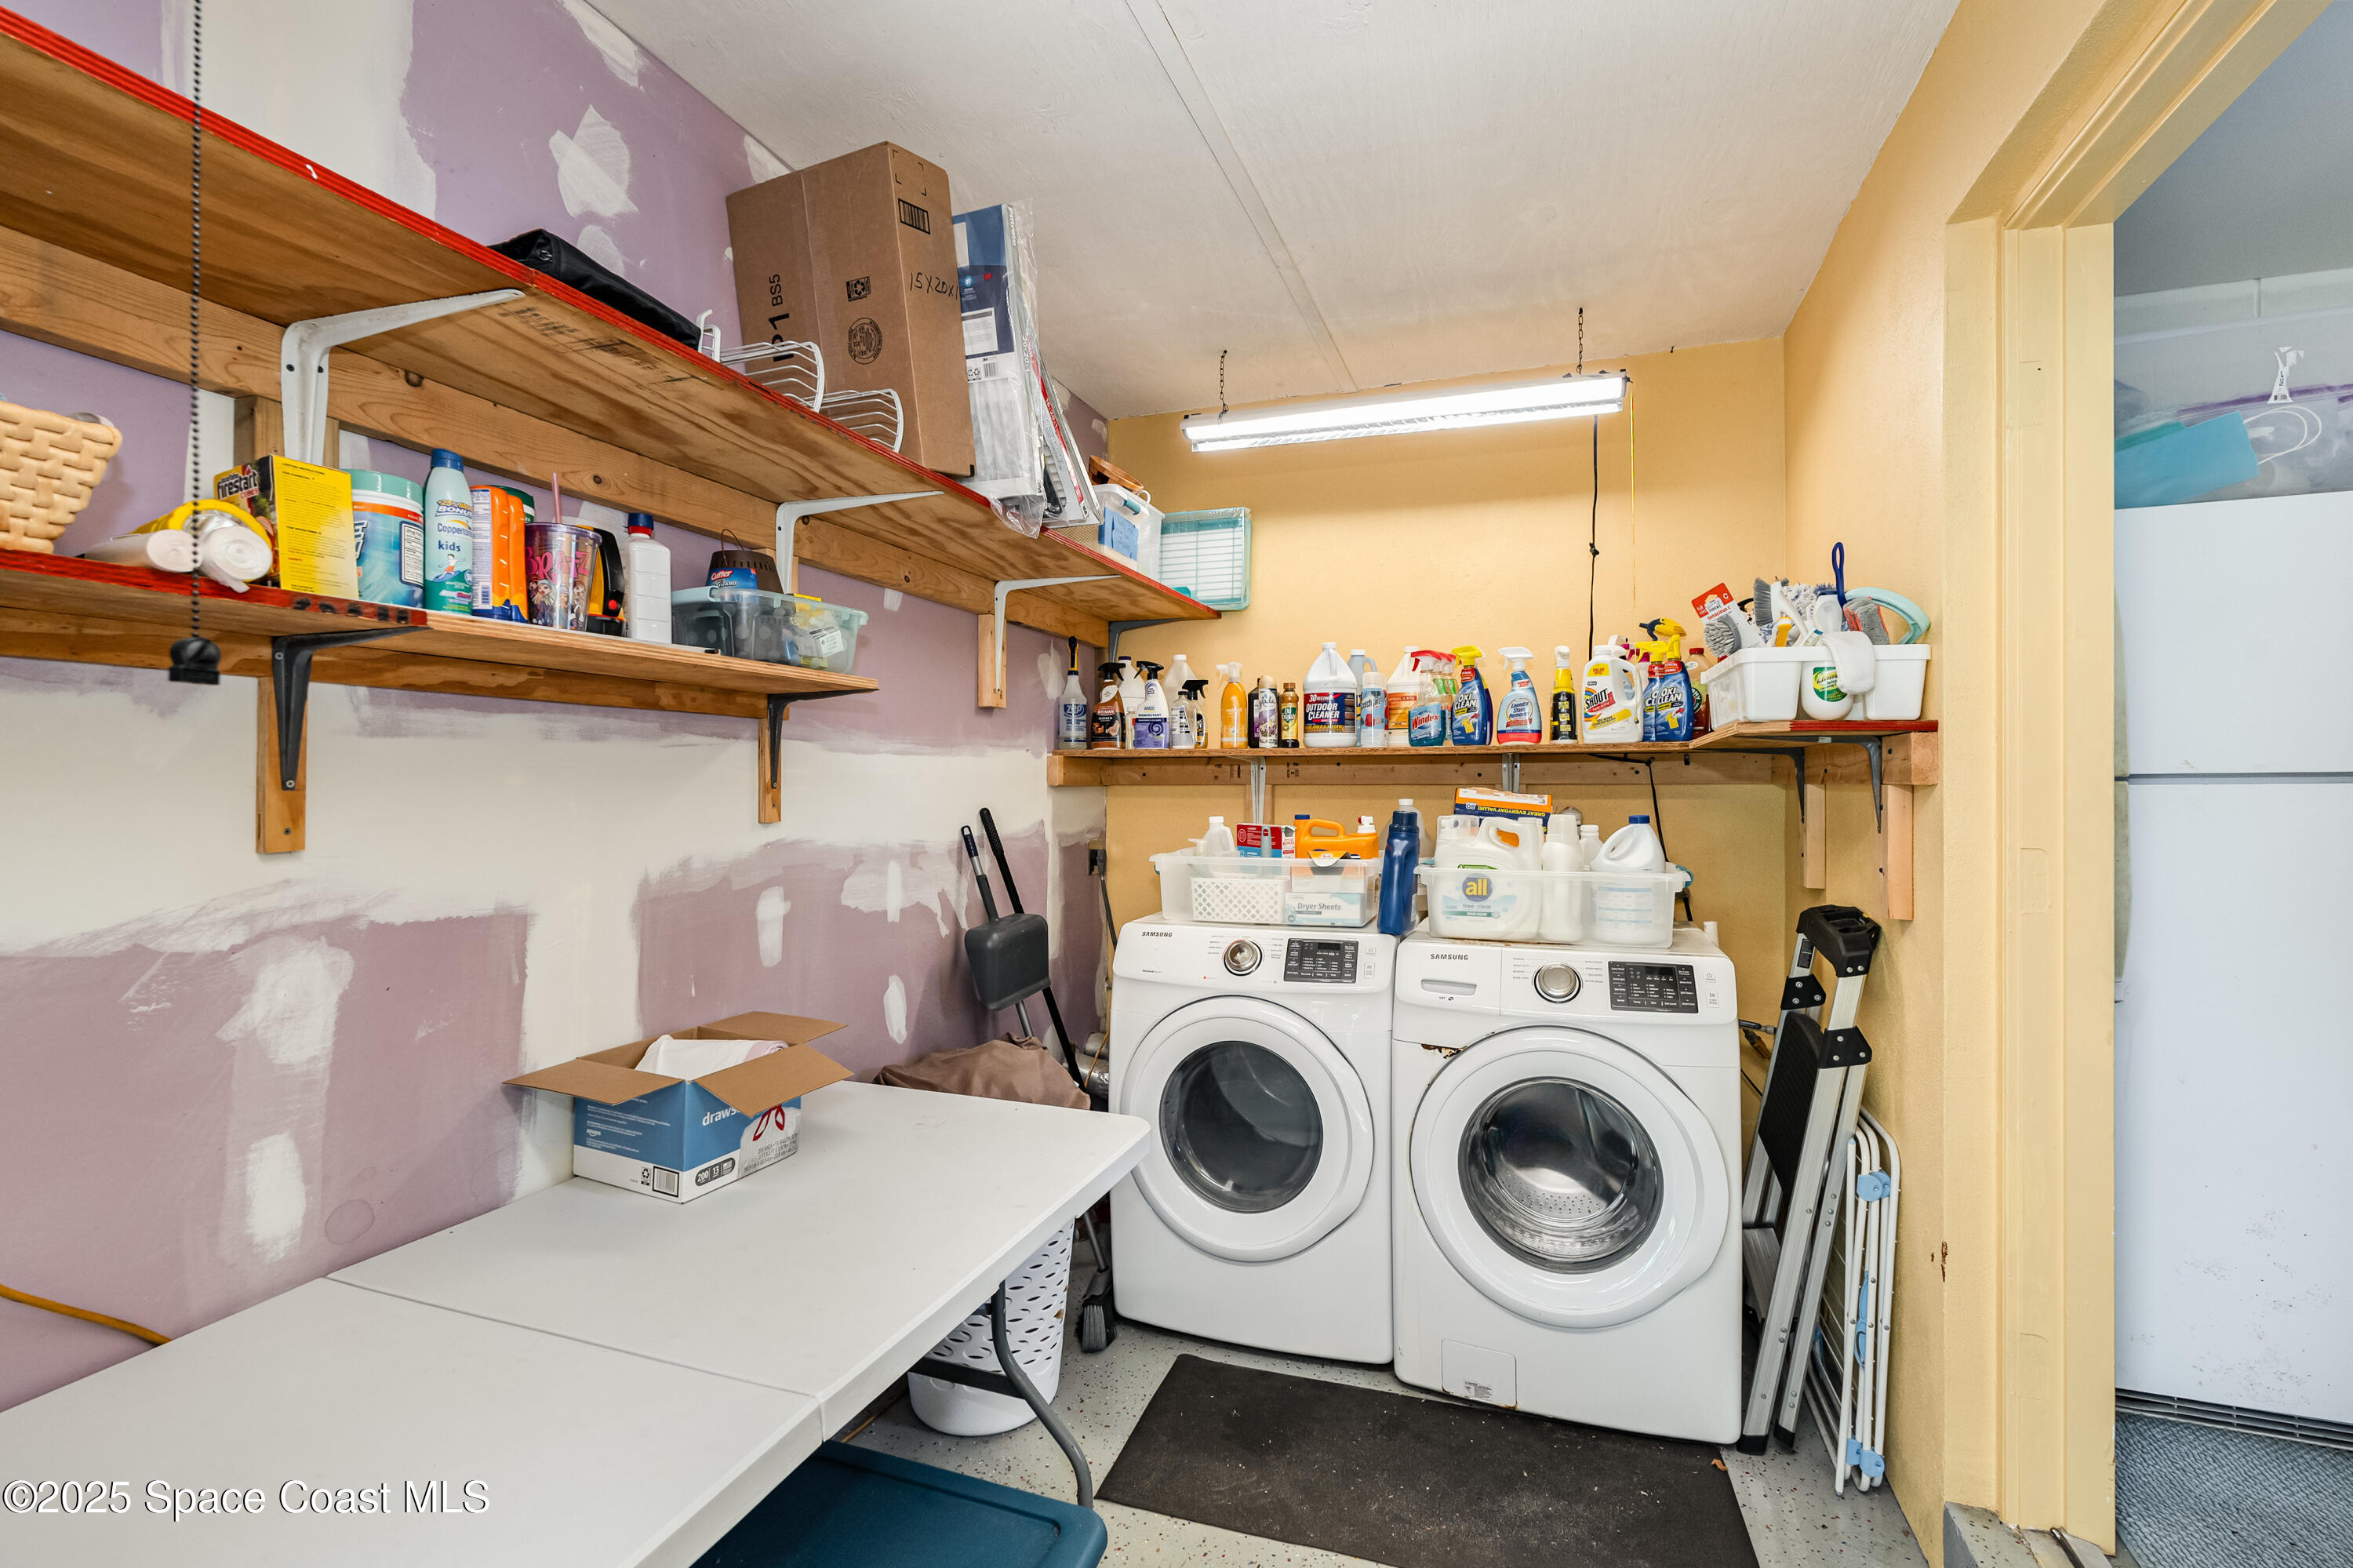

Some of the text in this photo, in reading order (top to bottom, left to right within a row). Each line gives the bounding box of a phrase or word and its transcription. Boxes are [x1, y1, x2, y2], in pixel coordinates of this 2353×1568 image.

[769, 274, 784, 307] BS5
[216, 470, 258, 500] firestart
[438, 540, 461, 551] kids
[711, 569, 733, 580] Cutter
[1458, 693, 1472, 702] OXI
[1661, 687, 1677, 697] OXI
[1309, 694, 1318, 703] 30
[1585, 688, 1608, 710] SHOUT
[1657, 693, 1682, 705] CLEAN
[1306, 703, 1338, 713] OUTDOOR
[1454, 699, 1477, 710] CLEAN
[1308, 711, 1340, 721] CLEANER
[1412, 713, 1439, 731] Windex
[1465, 879, 1488, 896] all
[1297, 902, 1317, 911] Dryer
[702, 1107, 740, 1126] draws
[713, 1165, 720, 1175] 13
[697, 1170, 709, 1182] 200
